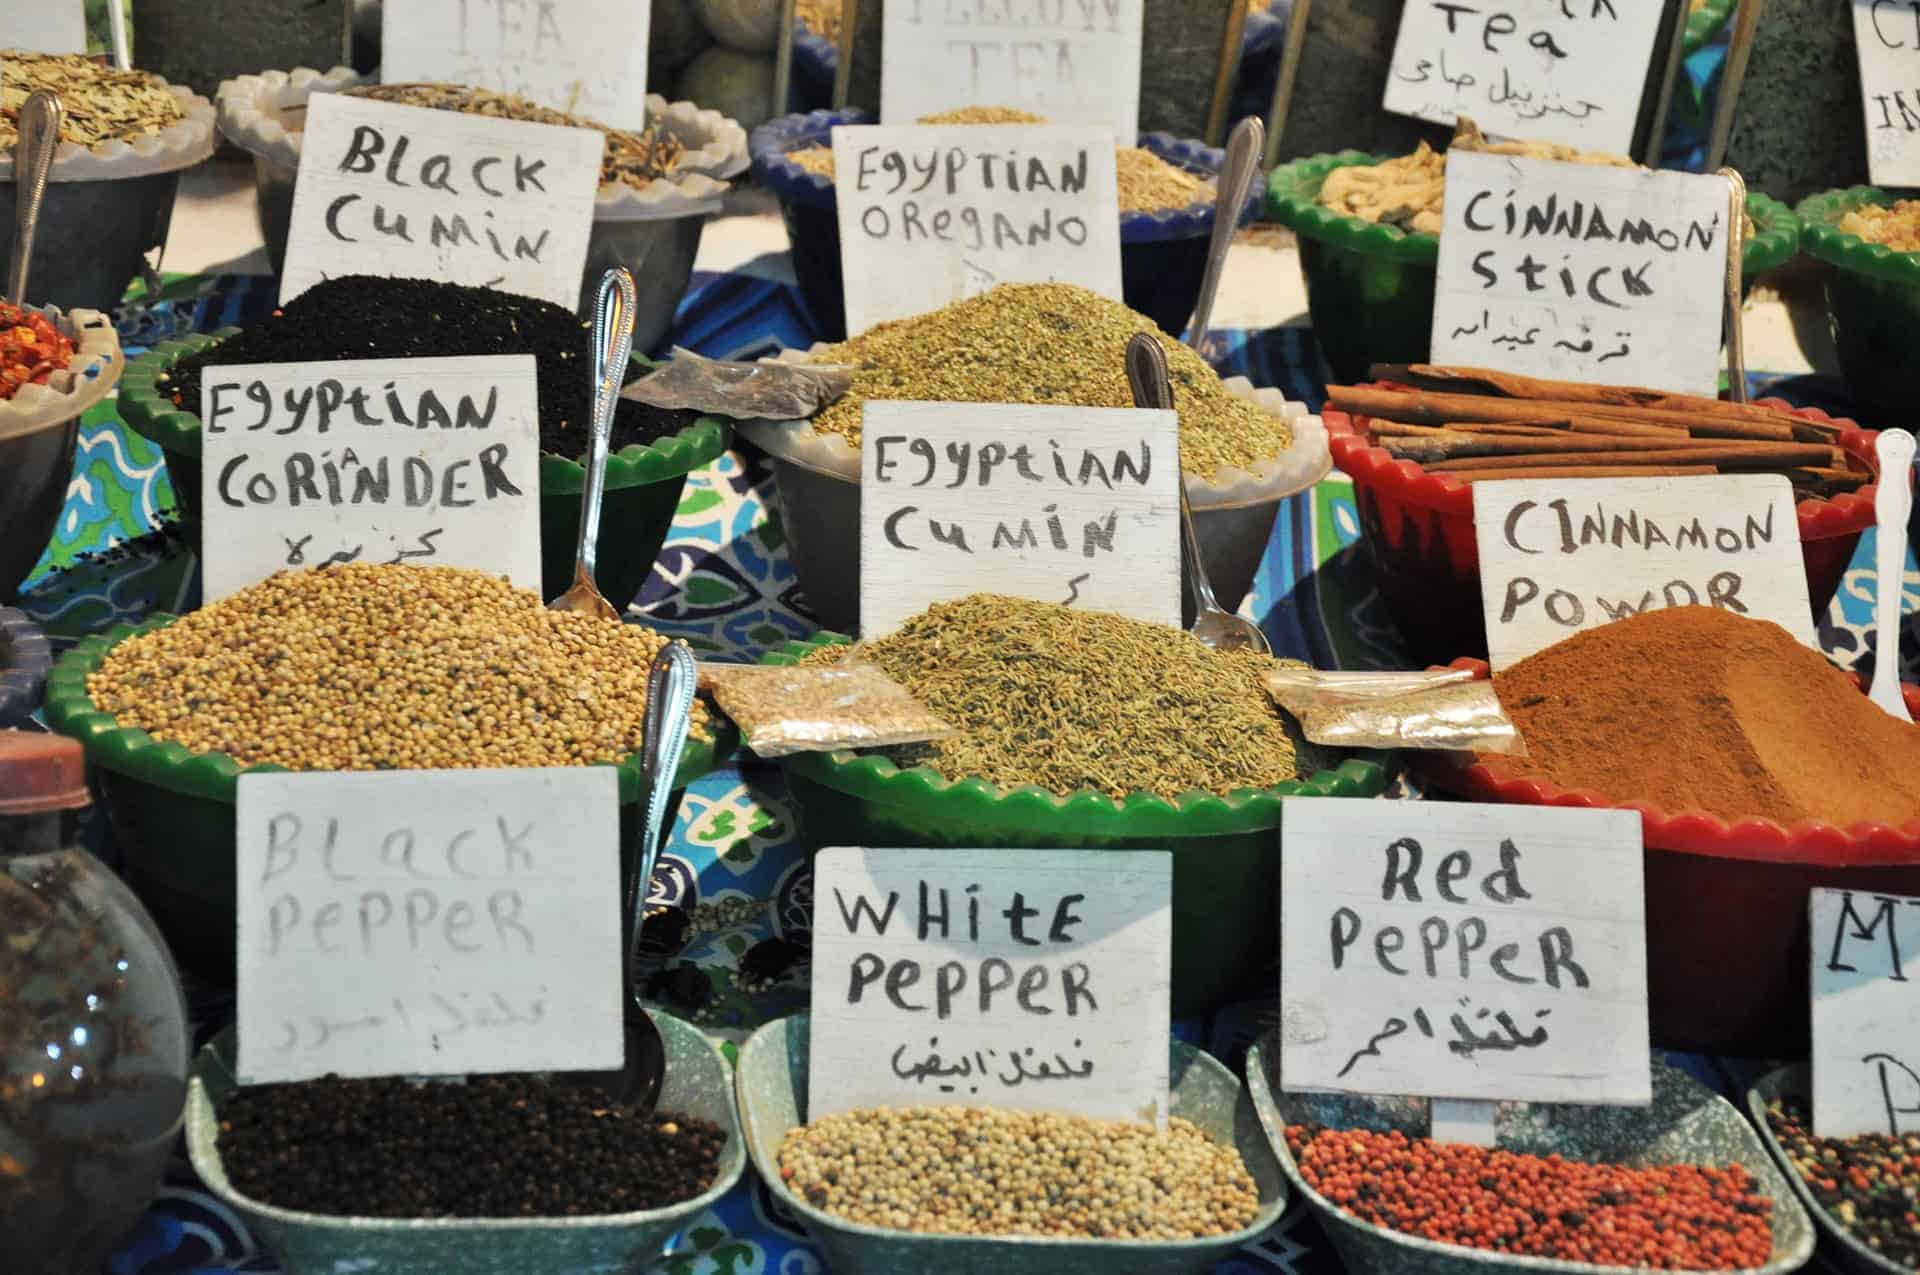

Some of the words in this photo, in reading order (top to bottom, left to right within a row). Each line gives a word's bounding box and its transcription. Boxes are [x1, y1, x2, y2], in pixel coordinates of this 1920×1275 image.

[1432, 3, 1569, 58] Tea
[1504, 498, 1775, 554] CINNAMON
[1382, 837, 1532, 904] Red
[1826, 891, 1920, 982] M
